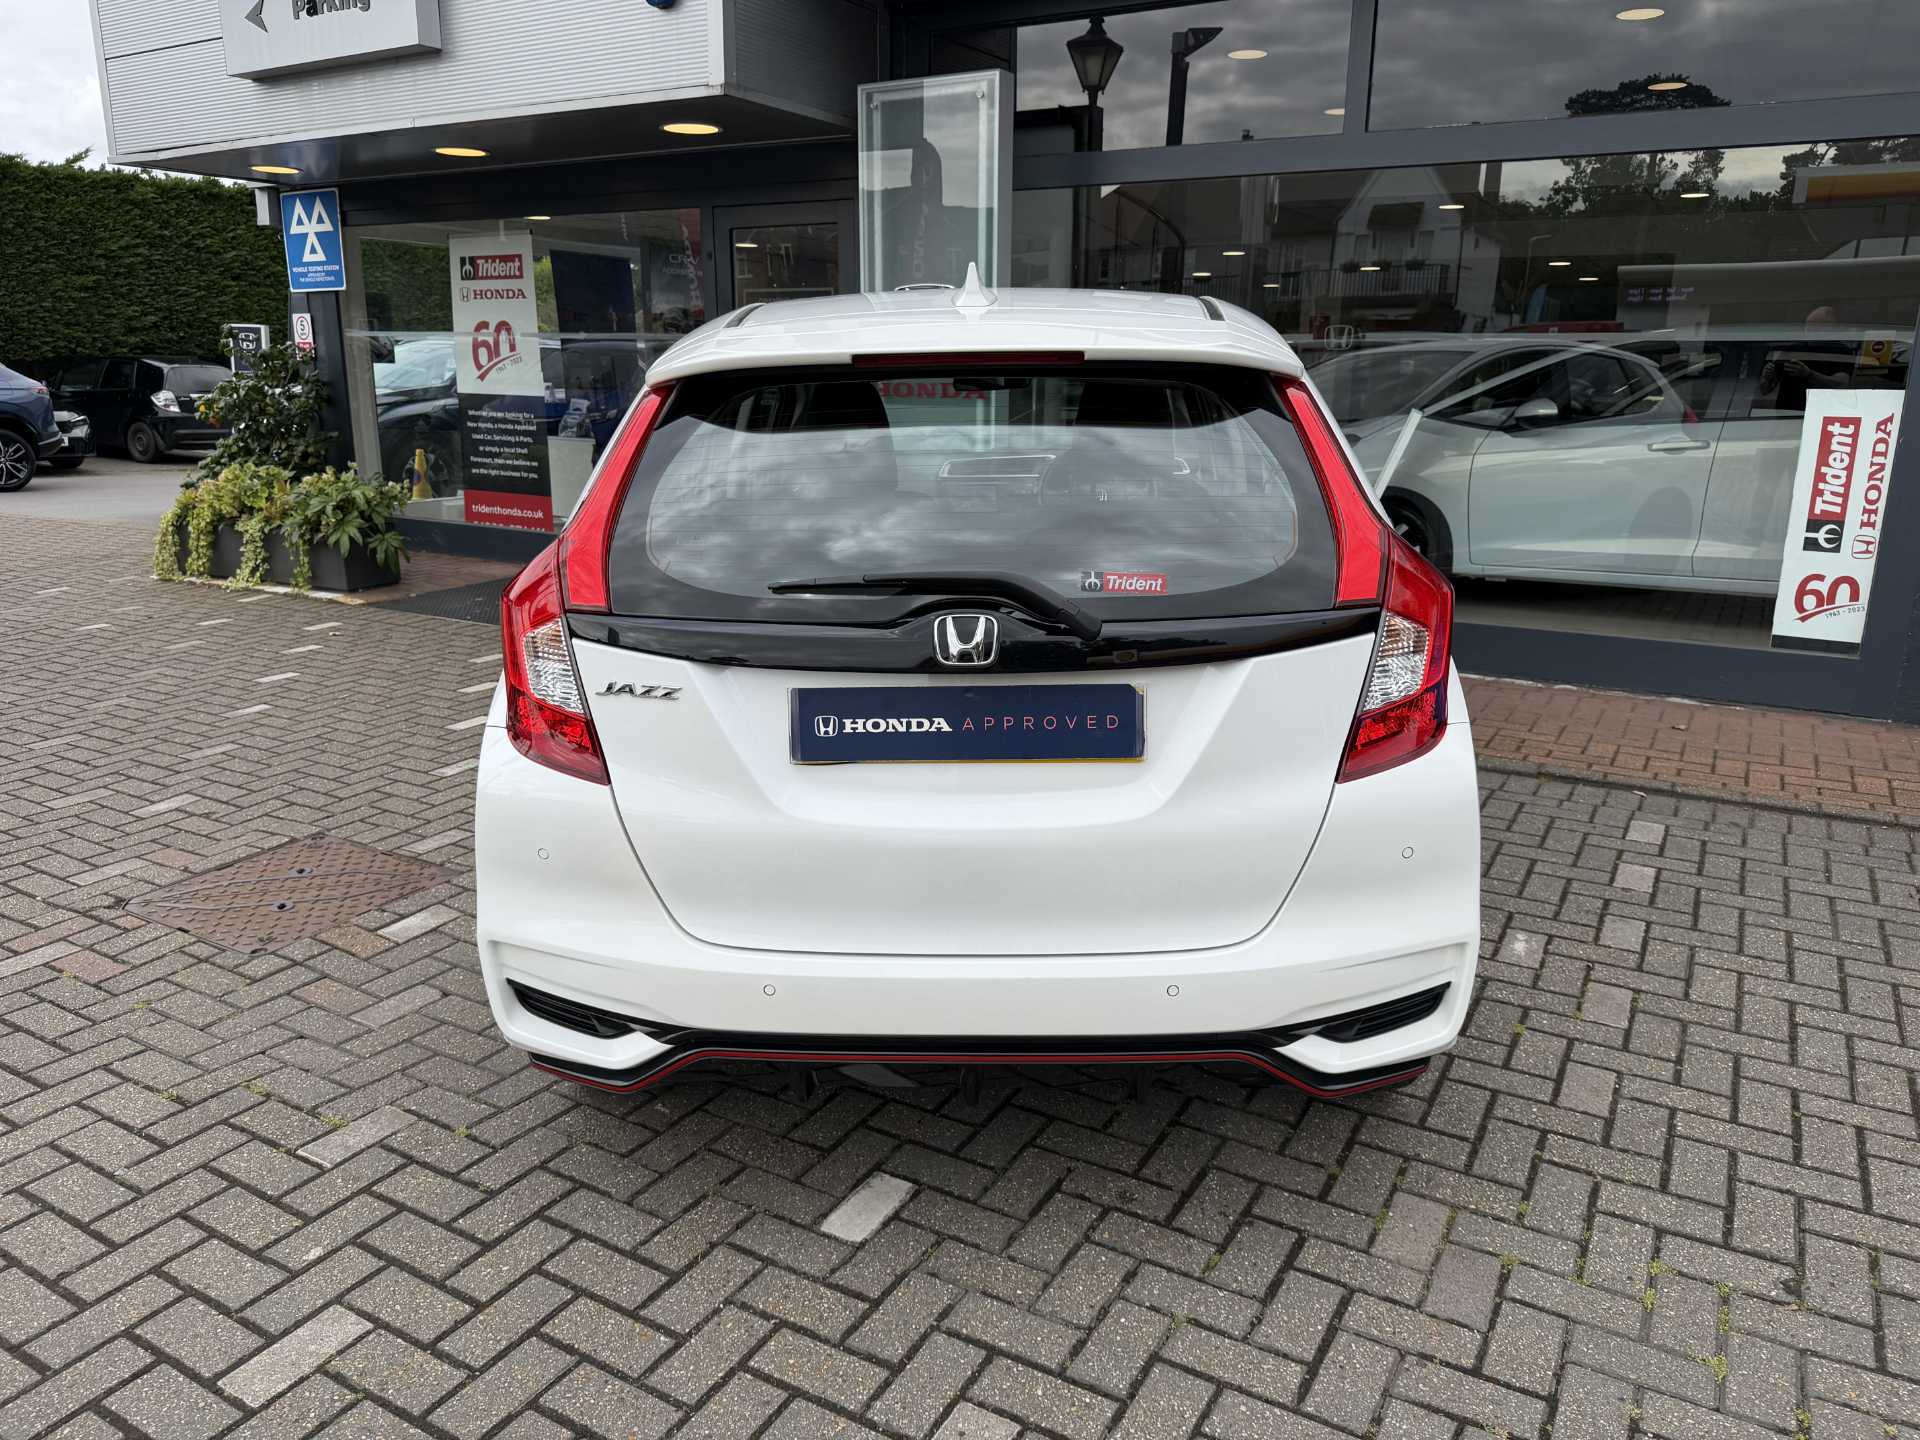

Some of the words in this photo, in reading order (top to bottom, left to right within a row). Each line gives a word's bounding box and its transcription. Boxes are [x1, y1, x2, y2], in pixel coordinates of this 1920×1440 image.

[476, 258, 521, 276] Trident
[473, 288, 527, 300] HONDA
[1814, 422, 1855, 515] Trident
[1859, 412, 1894, 530] HONDA
[472, 503, 544, 519] tridenthonda.co.uk
[1106, 575, 1162, 591] Trident
[1825, 610, 1841, 619] 1963
[1847, 605, 1866, 614] 2023
[595, 681, 682, 701] JAZZ
[842, 717, 953, 734] HONDA
[962, 714, 1119, 731] APPROVED
